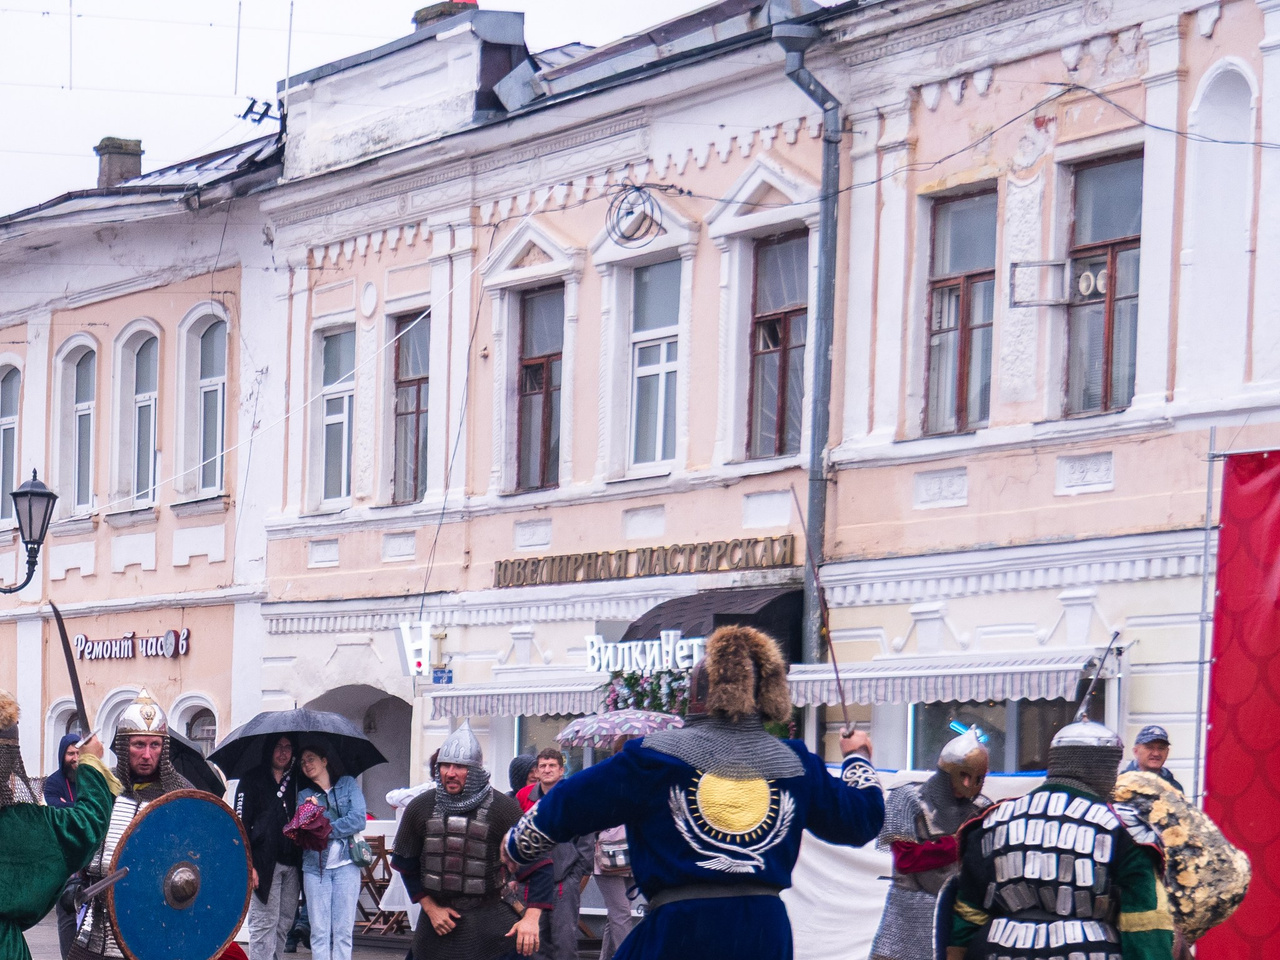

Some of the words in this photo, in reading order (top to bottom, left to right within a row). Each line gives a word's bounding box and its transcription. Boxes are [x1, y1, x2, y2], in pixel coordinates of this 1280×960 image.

[493, 550, 629, 588] ЮВЕЛИРНАЯ
[636, 534, 795, 576] МАСТЕРСКАЯ
[74, 632, 135, 660] Ремонт
